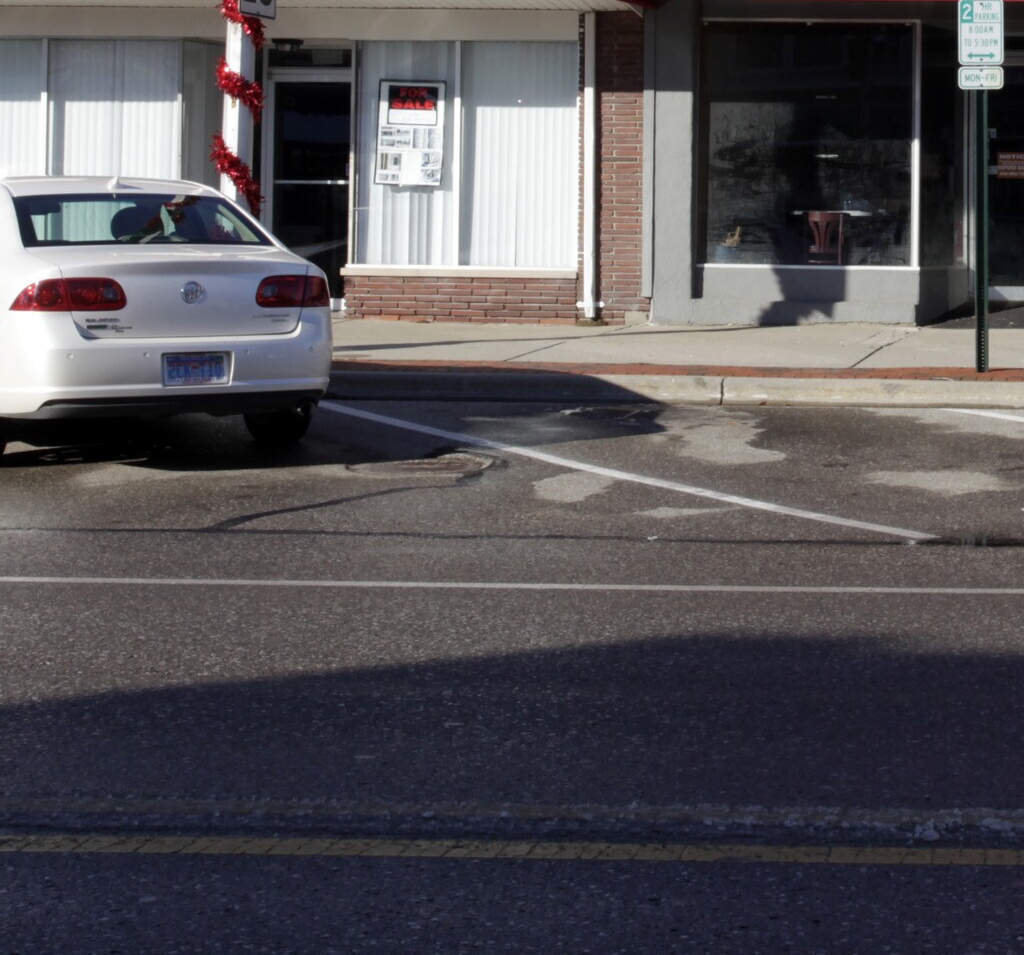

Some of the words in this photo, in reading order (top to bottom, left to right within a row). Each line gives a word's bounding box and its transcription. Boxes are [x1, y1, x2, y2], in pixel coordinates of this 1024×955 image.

[962, 3, 972, 20] 2
[981, 2, 993, 11] HR
[974, 12, 1000, 21] PARKING
[964, 38, 972, 47] TO
[964, 73, 998, 82] MON-FRI
[399, 87, 429, 98] FOR
[391, 98, 434, 110] SALE
